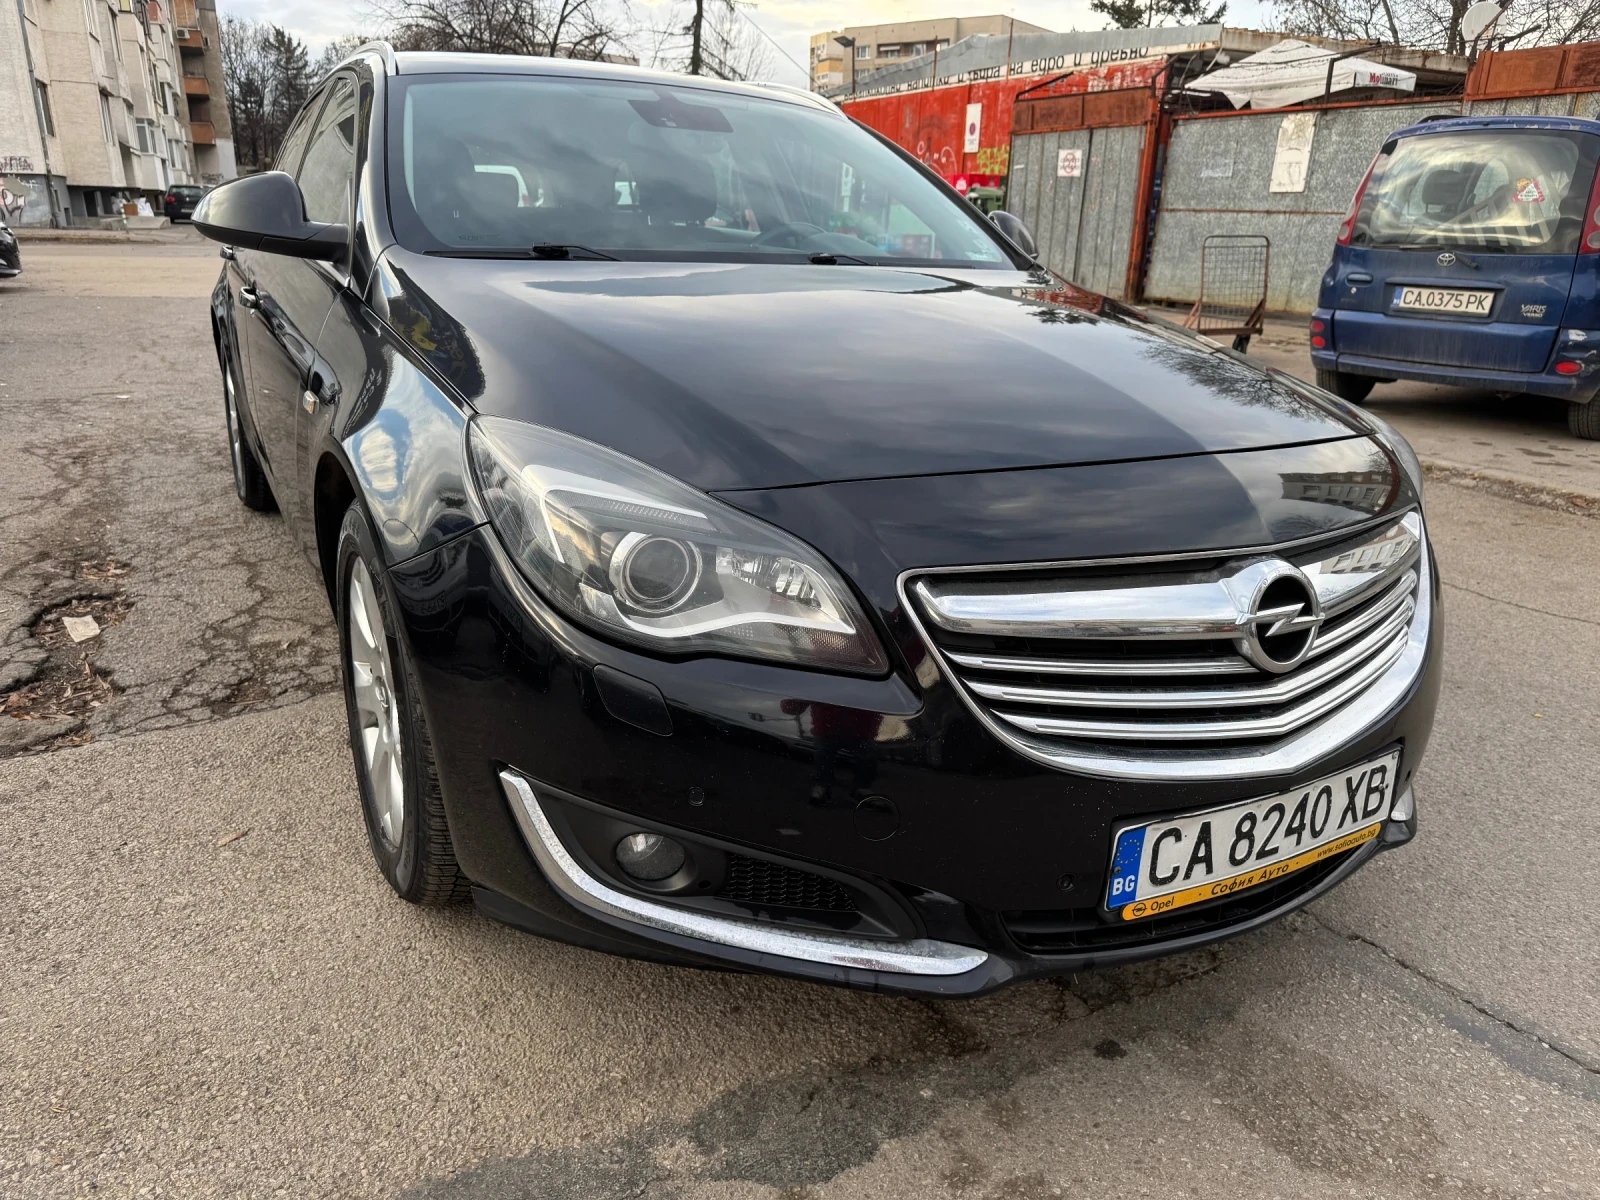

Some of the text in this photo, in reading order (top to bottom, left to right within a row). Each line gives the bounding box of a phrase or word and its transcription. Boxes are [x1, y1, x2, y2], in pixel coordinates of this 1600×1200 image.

[1010, 61, 1024, 75] на
[1031, 55, 1064, 76] едро
[1073, 52, 1082, 67] и
[1148, 764, 1388, 886] CA 8240 XB
[1112, 875, 1136, 896] BG
[1150, 828, 1377, 912] Opel София Ауто www.sofiaauto.bg
